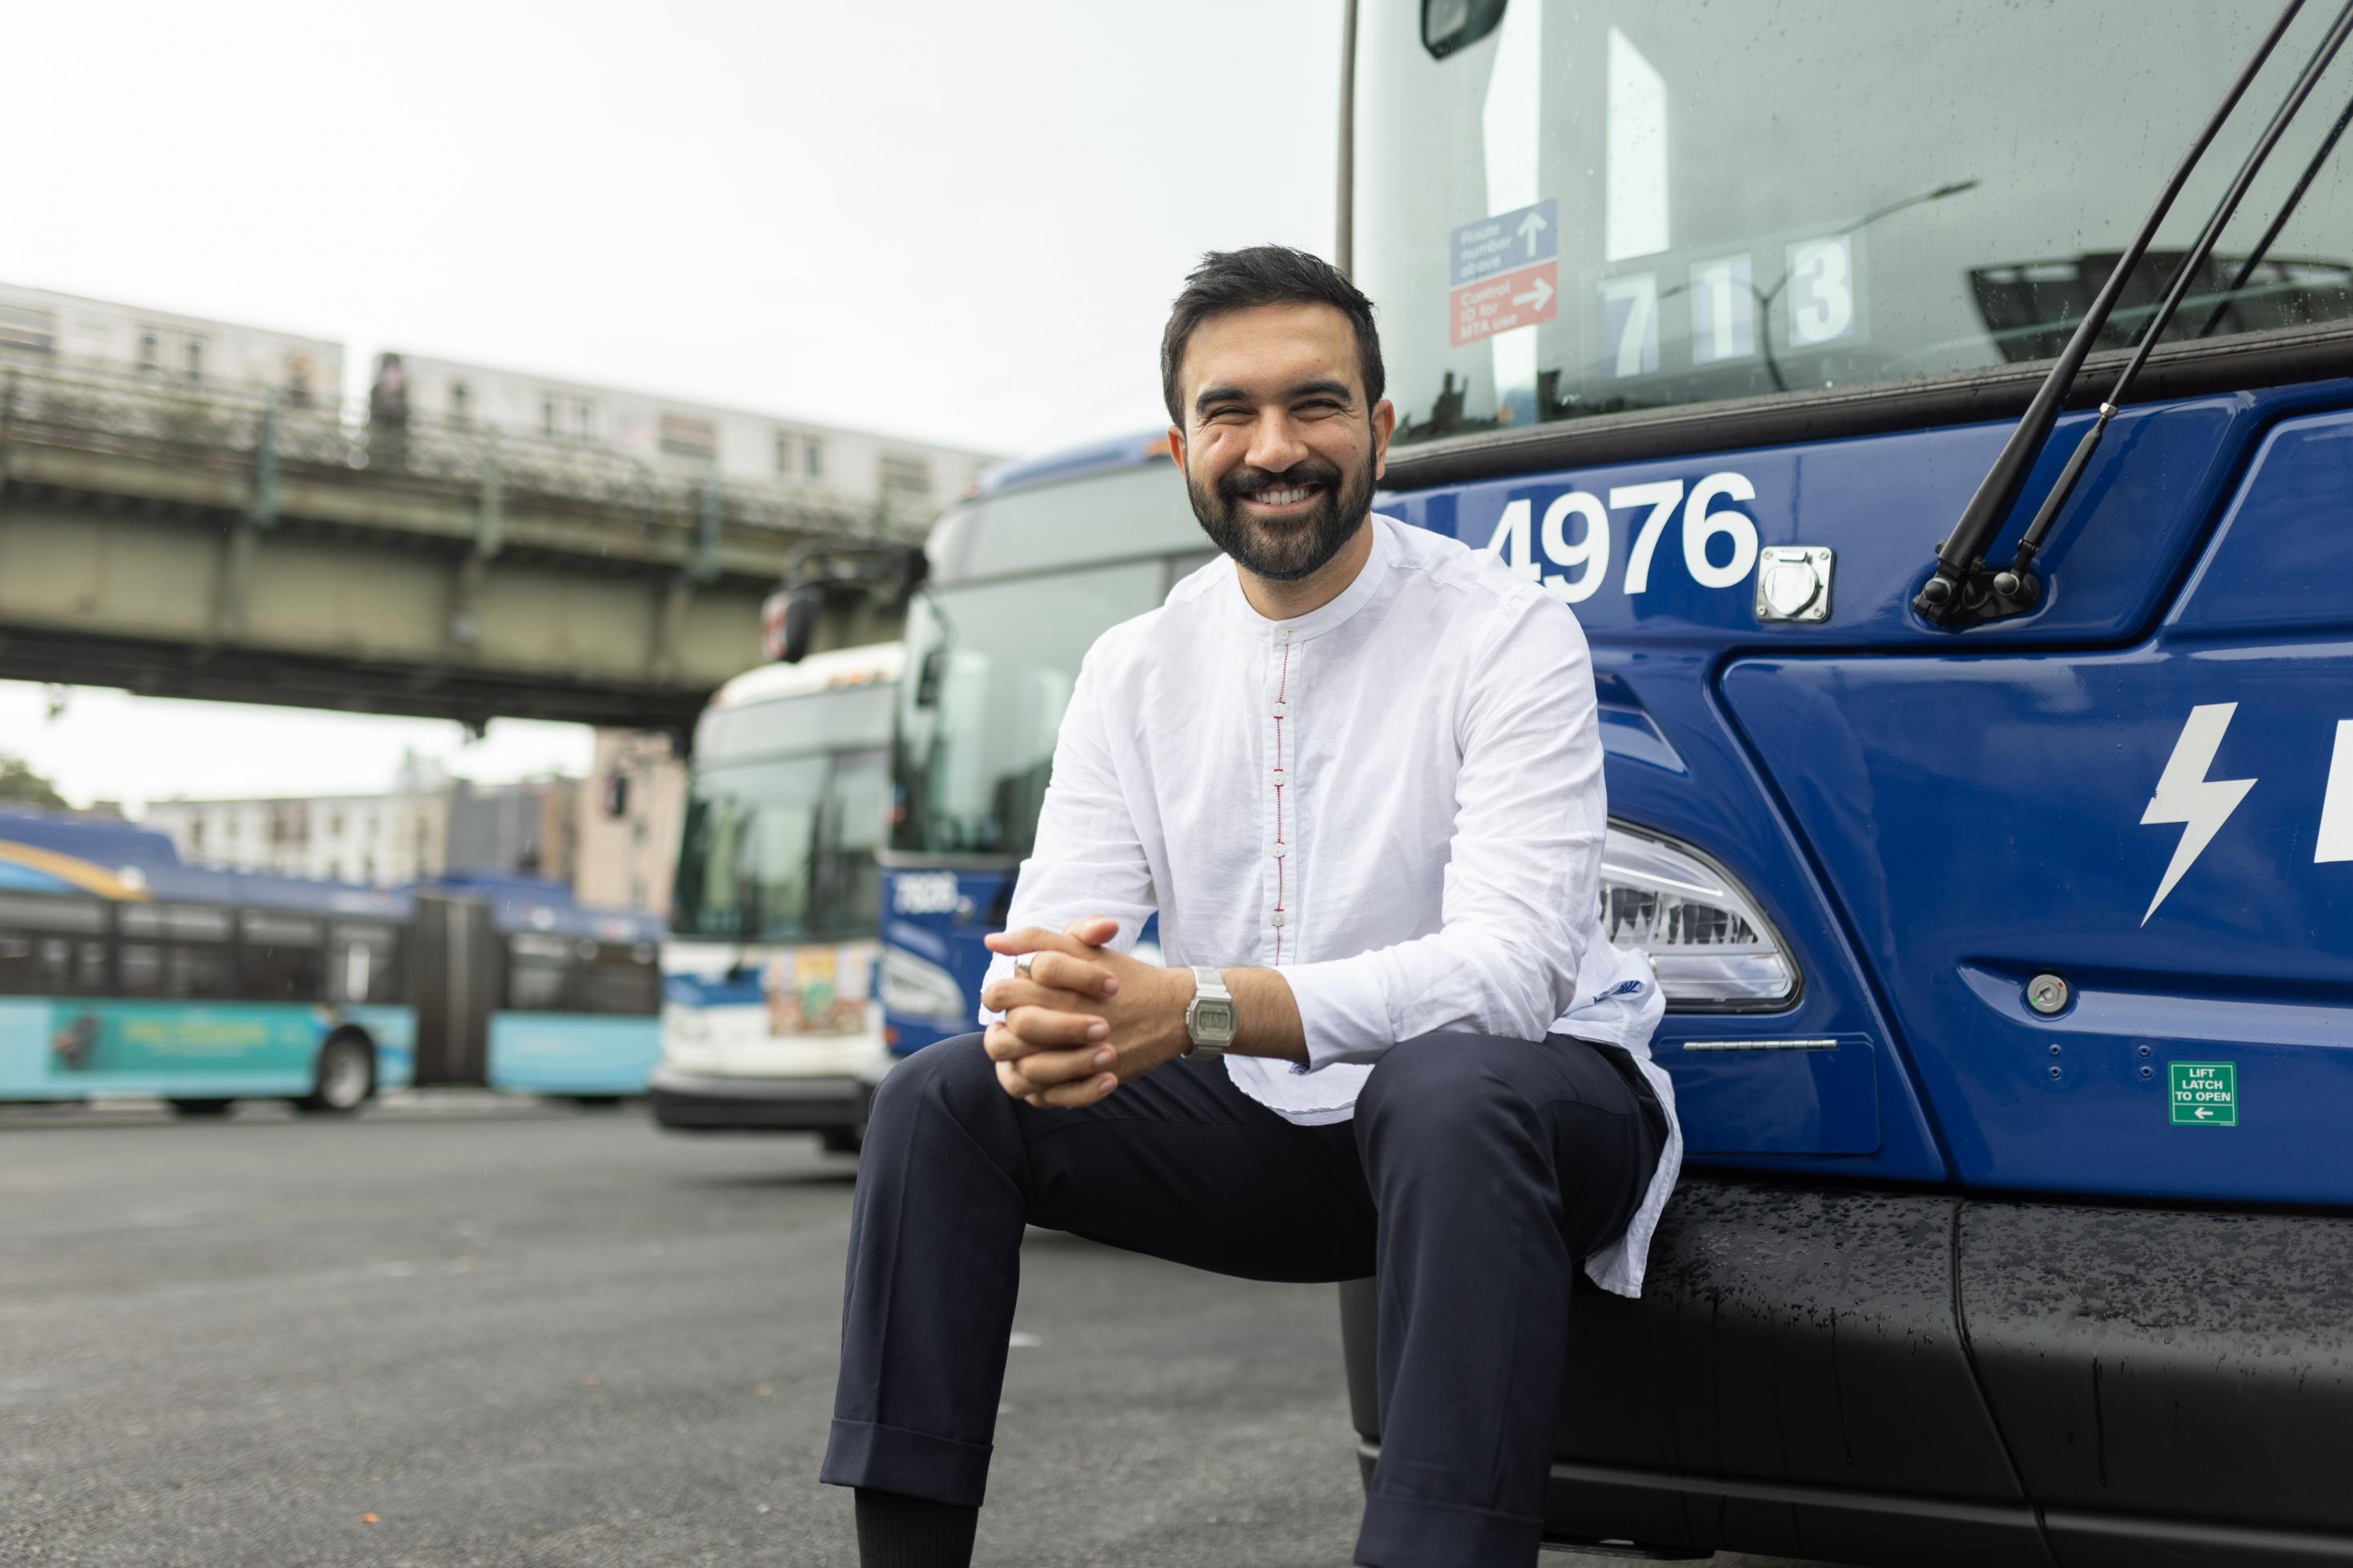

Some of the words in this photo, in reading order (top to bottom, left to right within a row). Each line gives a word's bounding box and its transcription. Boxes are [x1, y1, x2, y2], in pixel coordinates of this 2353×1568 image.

[1460, 224, 1500, 244] Route
[1460, 237, 1512, 261] number
[1460, 257, 1501, 278] above
[1460, 282, 1511, 307] Control
[1460, 307, 1476, 322] ID
[1481, 303, 1499, 318] for
[1460, 319, 1489, 339] MTA
[1492, 314, 1518, 330] use
[1488, 471, 1758, 604] 4976
[2189, 1069, 2215, 1077] LIFT
[2182, 1080, 2223, 1089] LATCH
[2175, 1091, 2192, 1101] TO
[2195, 1092, 2231, 1101] OPEN
